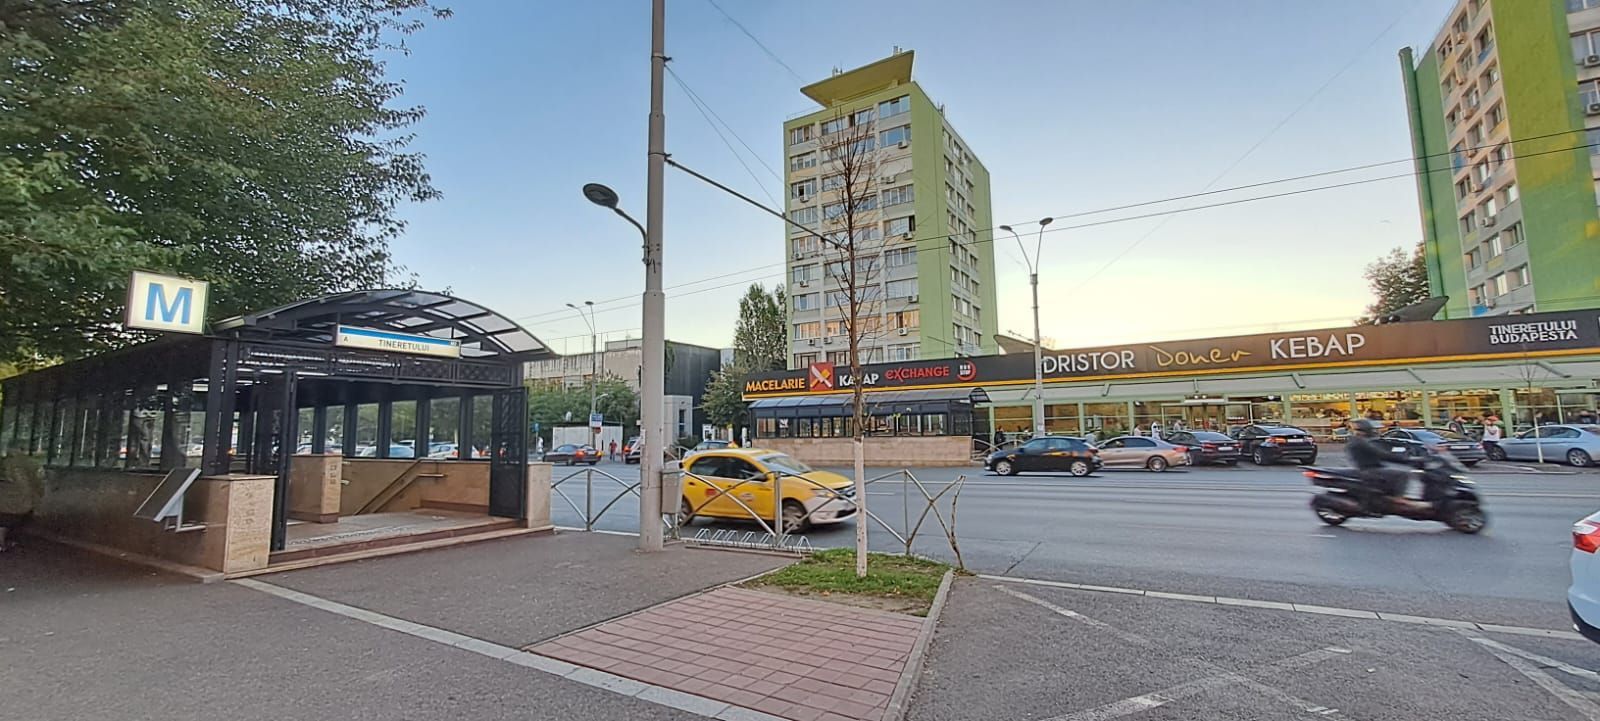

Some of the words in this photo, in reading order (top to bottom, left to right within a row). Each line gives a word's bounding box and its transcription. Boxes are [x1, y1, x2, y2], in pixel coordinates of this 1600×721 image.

[145, 282, 193, 325] M
[1489, 320, 1577, 335] TINERETULUI
[379, 340, 430, 351] TINERETULUI
[1490, 330, 1578, 344] BUDAPESTA
[1043, 350, 1135, 373] DRISTOR
[1270, 333, 1365, 359] KEBAP
[746, 378, 806, 392] MACELARIE
[839, 373, 879, 386] KAAP
